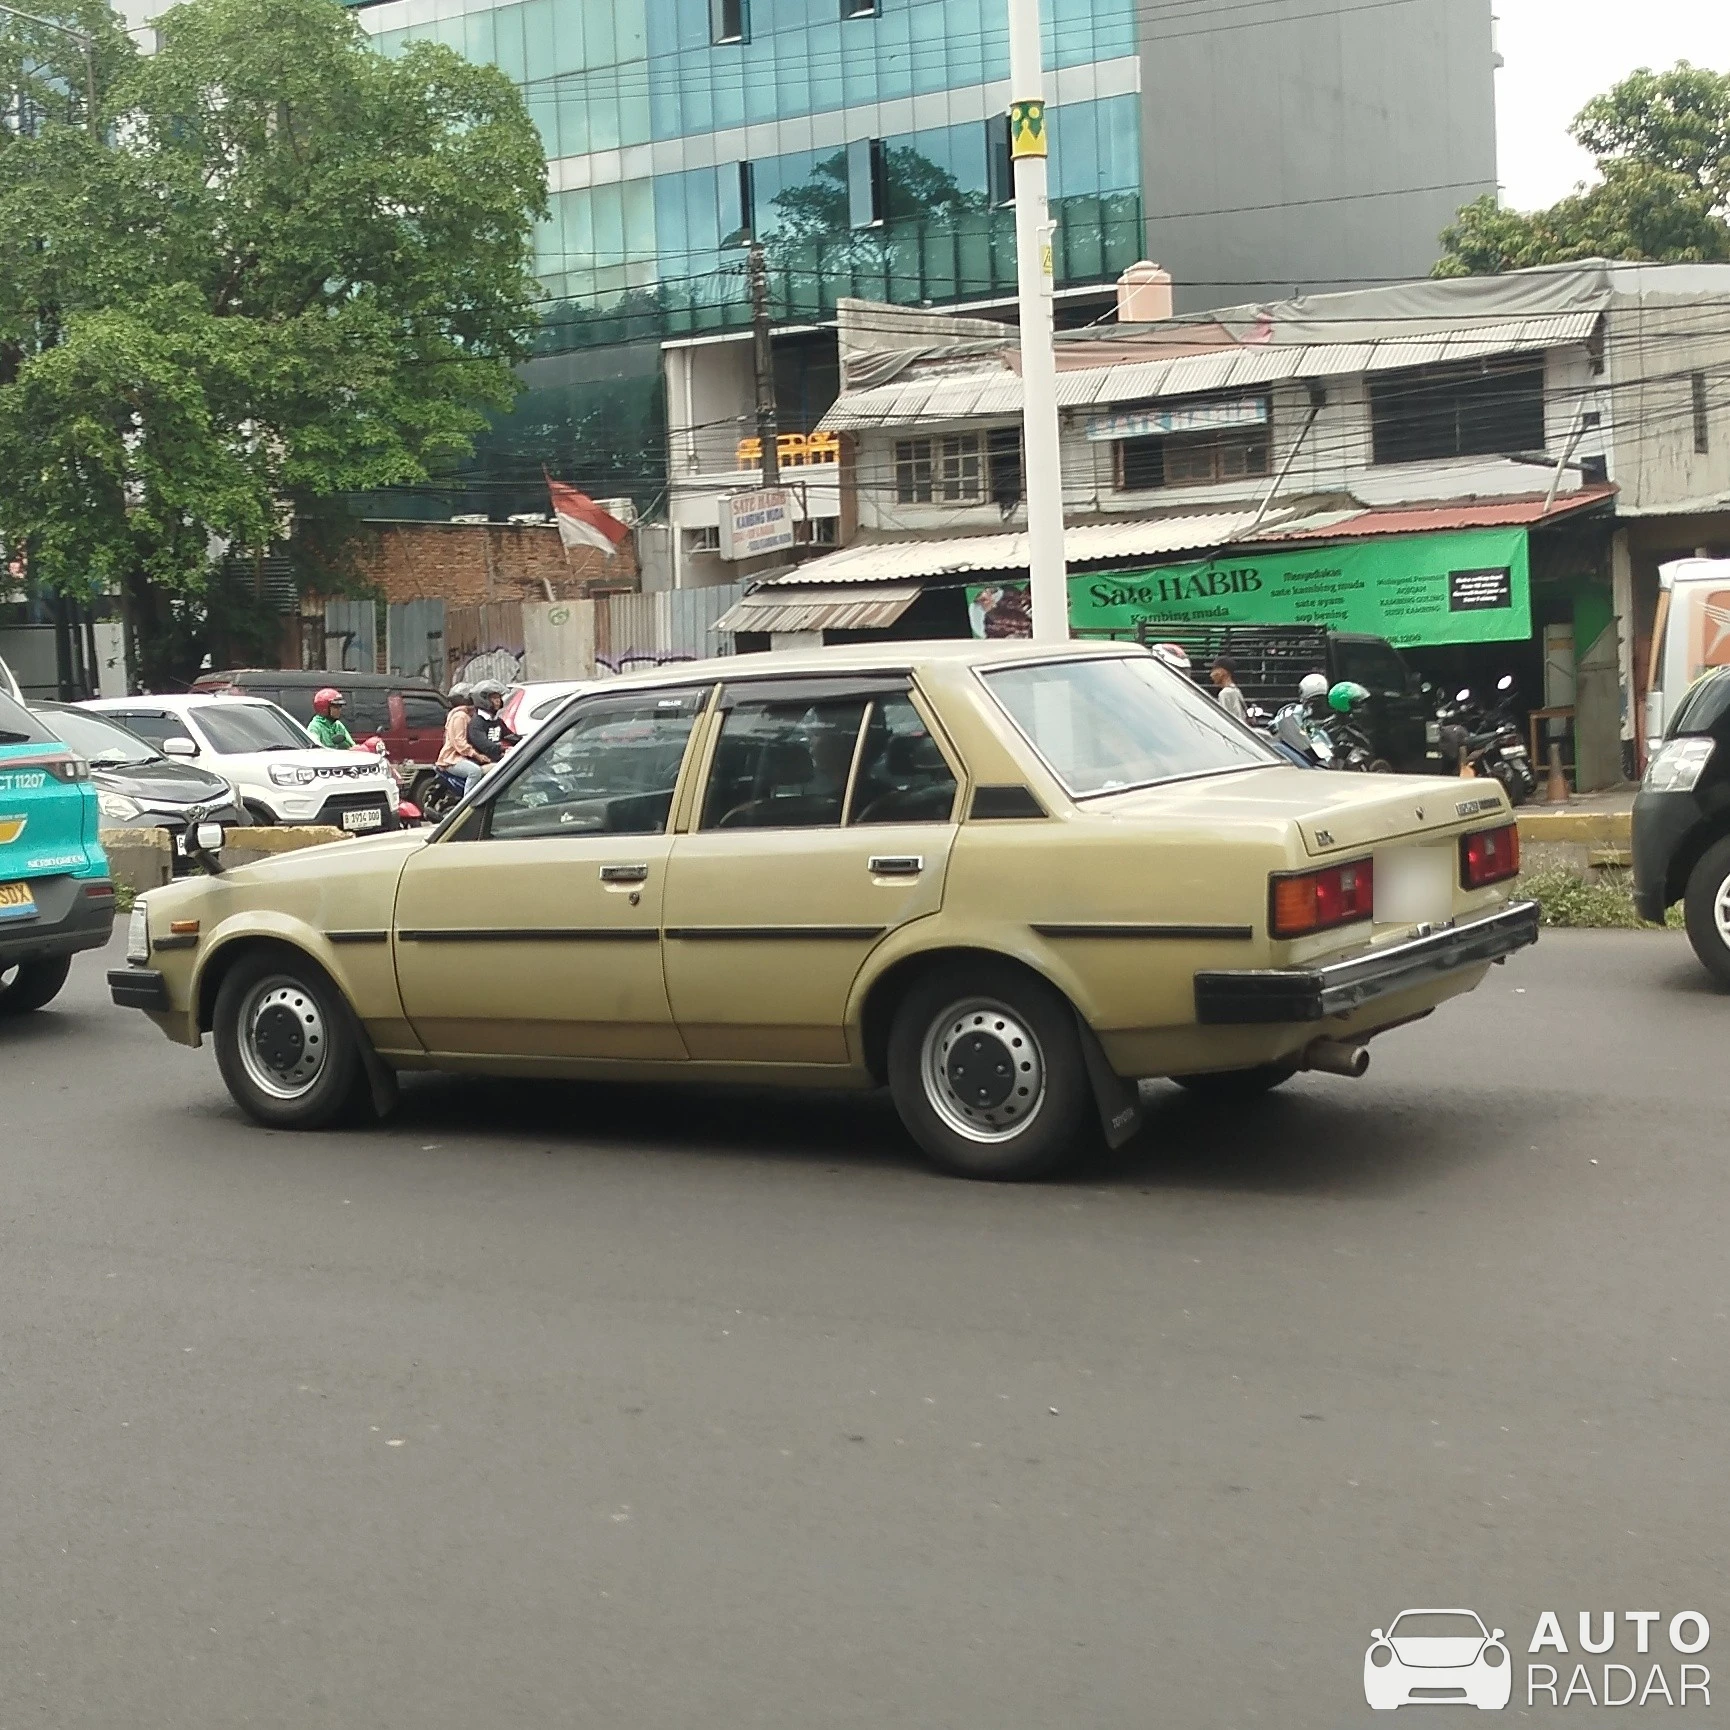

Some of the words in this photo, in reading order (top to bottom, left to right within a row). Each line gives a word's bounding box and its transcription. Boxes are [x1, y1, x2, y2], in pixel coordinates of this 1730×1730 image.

[1089, 583, 1153, 608] Sate
[1158, 568, 1263, 602] HABIB
[1270, 588, 1291, 597] sate
[1292, 583, 1337, 595] kambing
[1338, 580, 1365, 591] muda
[1295, 599, 1316, 608] sate
[1192, 605, 1229, 619] muda
[15, 773, 46, 788] 11207
